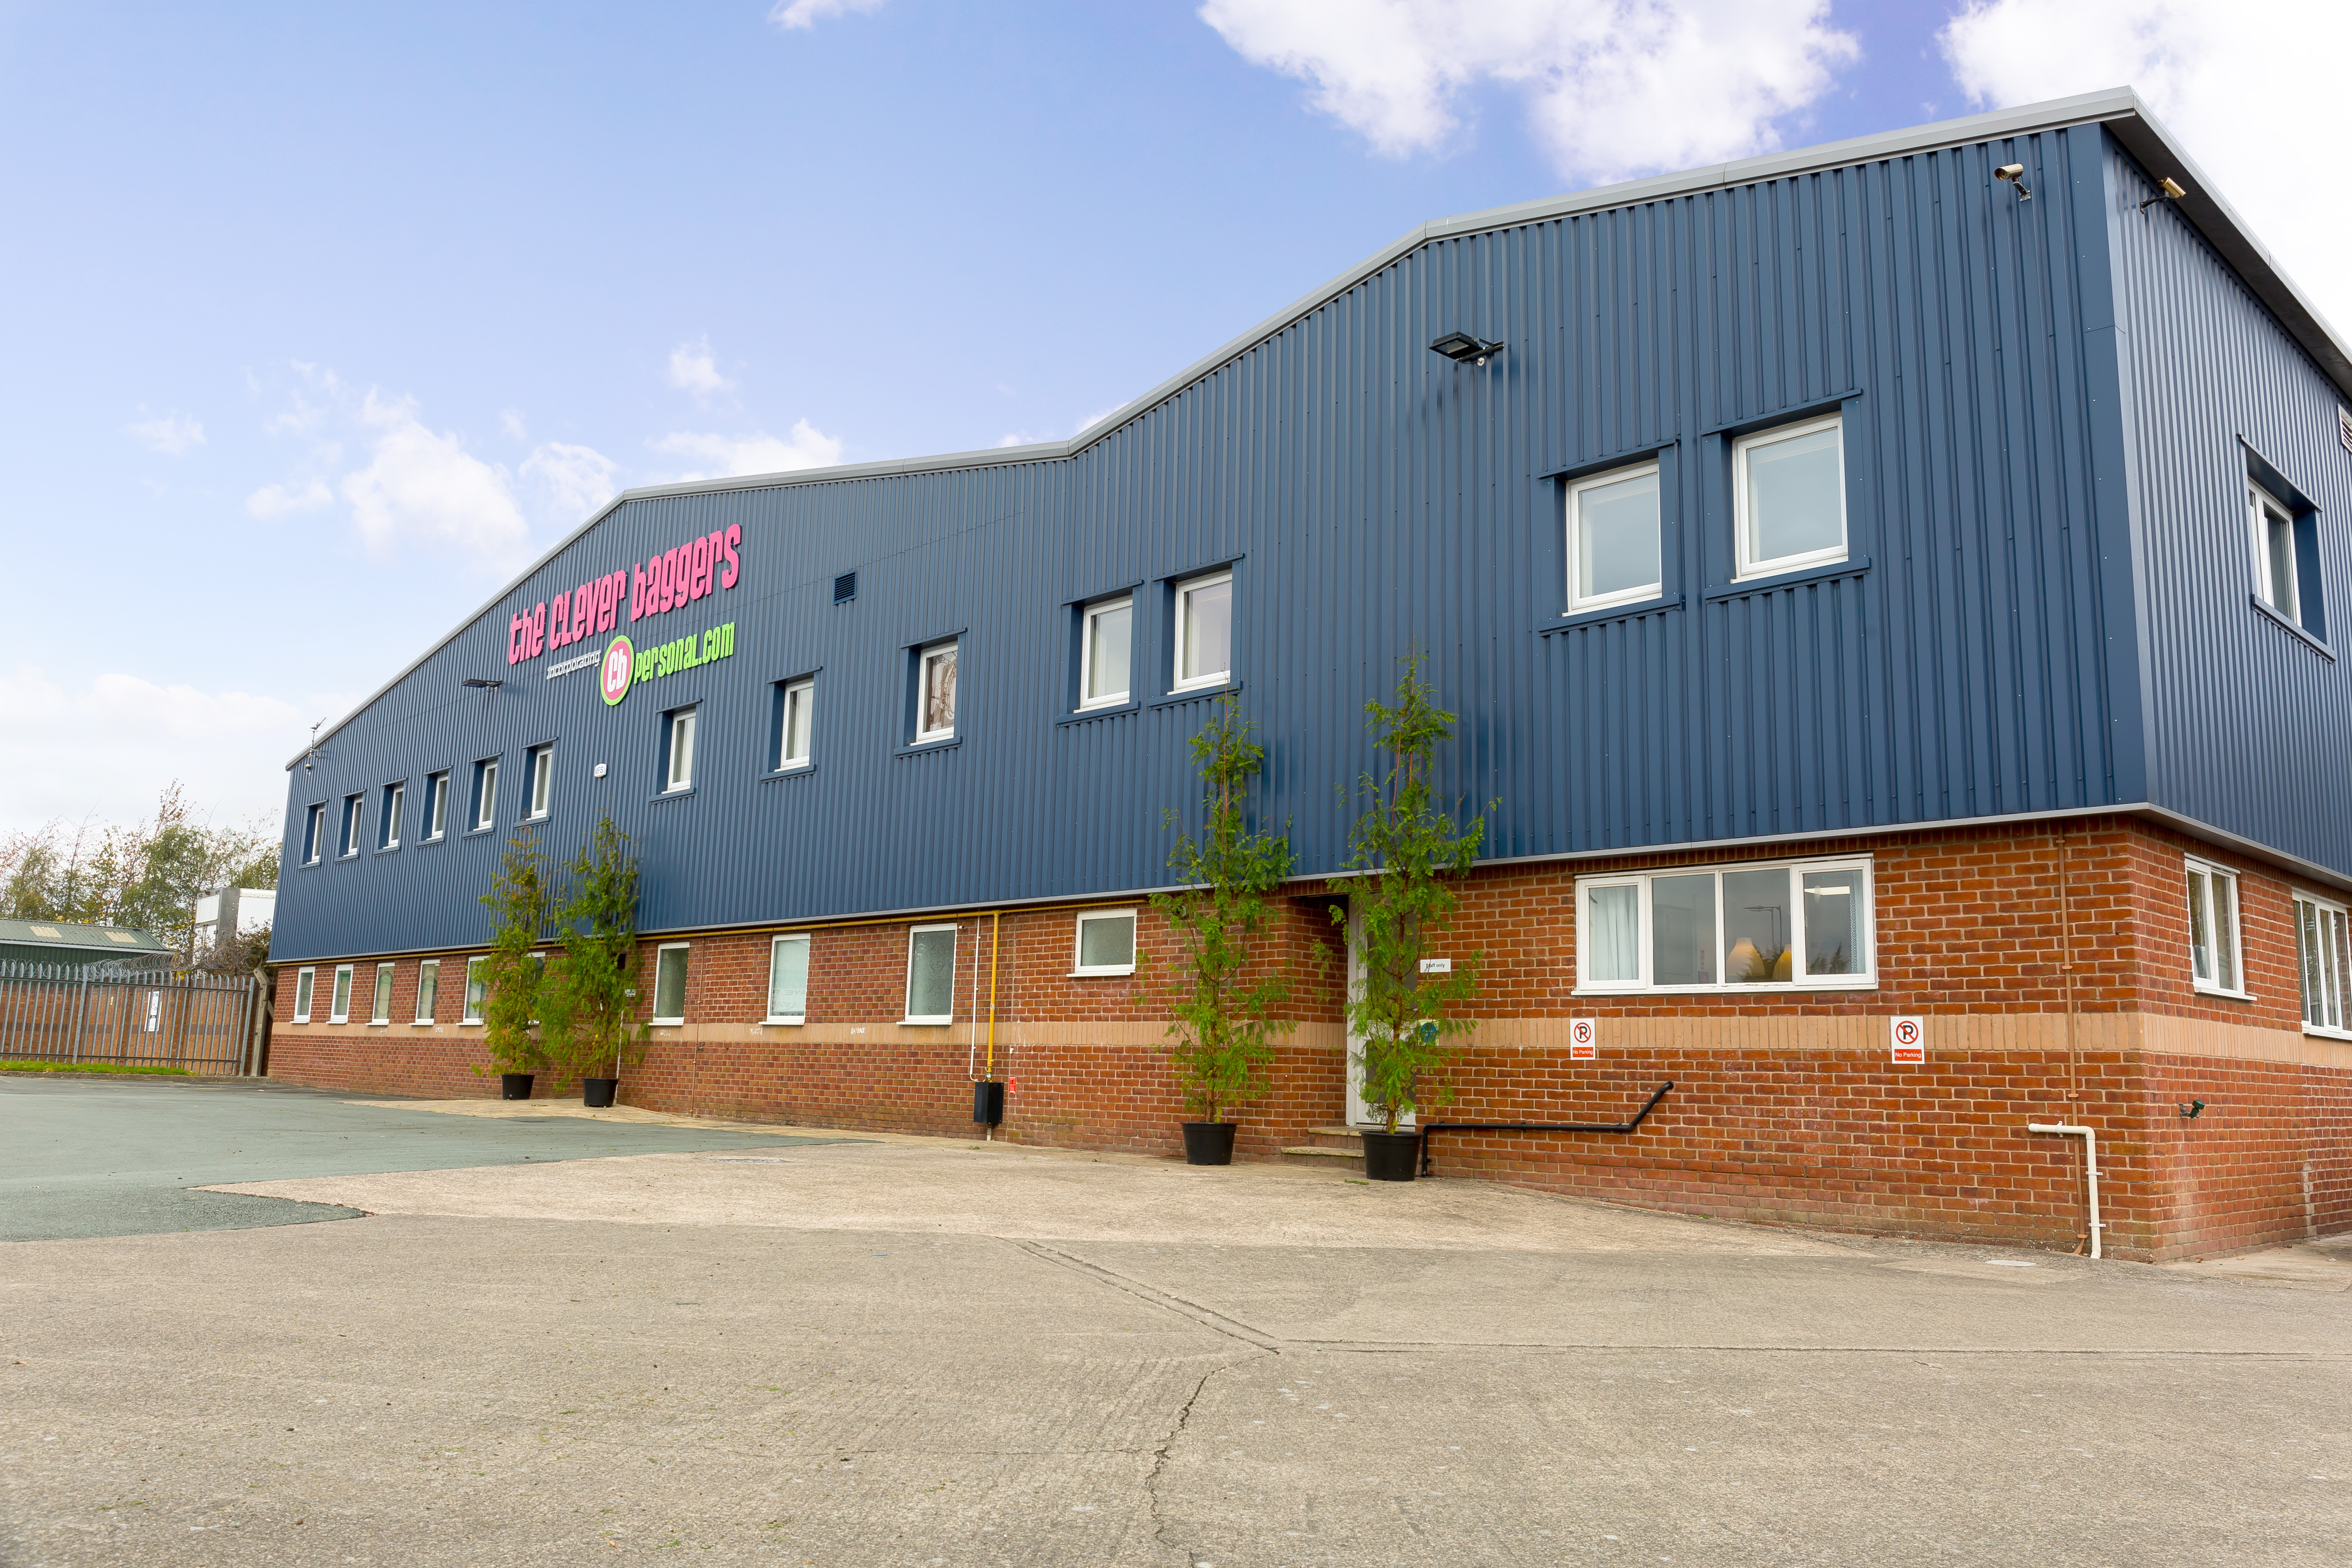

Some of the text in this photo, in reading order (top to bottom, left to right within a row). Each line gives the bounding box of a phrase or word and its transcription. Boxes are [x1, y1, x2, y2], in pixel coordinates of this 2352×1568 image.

[509, 601, 545, 665] the
[630, 523, 741, 622] baggers
[547, 652, 600, 678] incorporating
